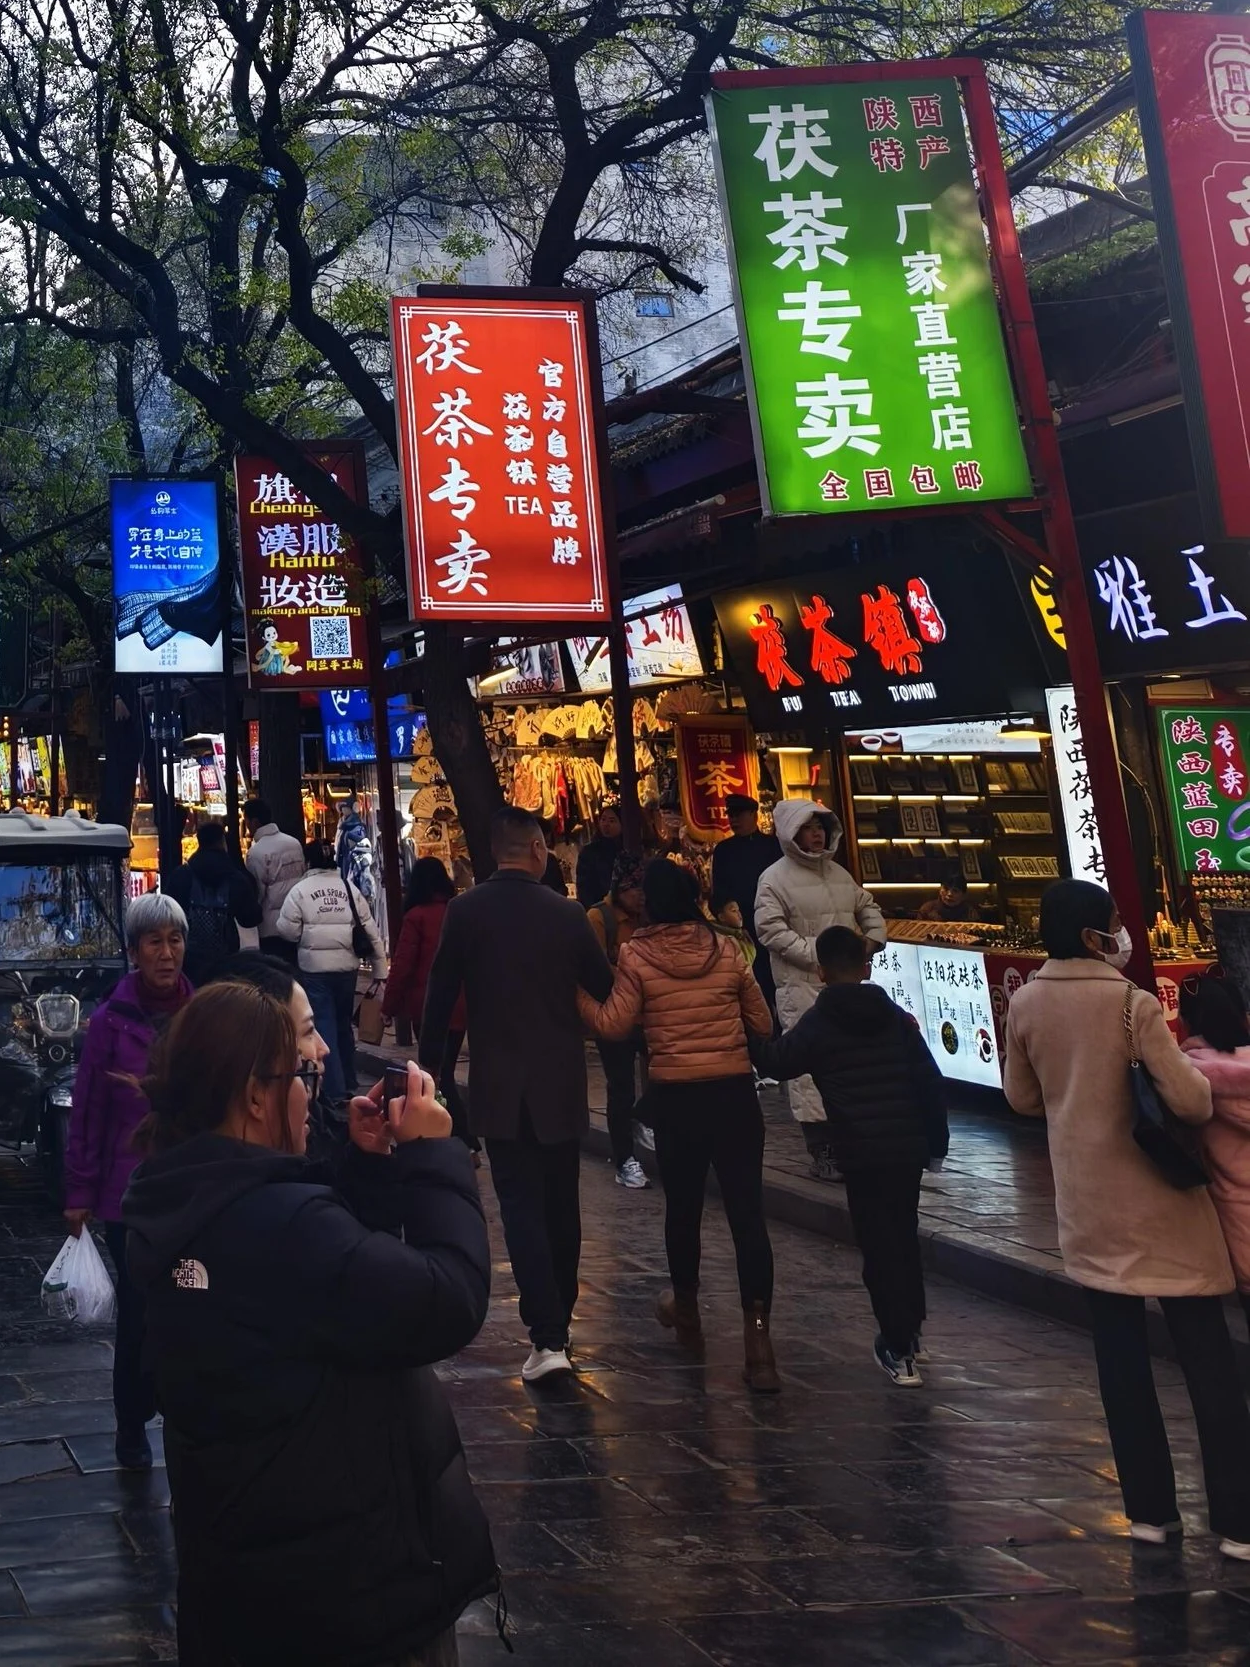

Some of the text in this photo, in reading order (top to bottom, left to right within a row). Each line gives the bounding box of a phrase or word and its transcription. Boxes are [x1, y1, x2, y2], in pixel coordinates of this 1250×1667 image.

[863, 93, 944, 132] 陕西
[869, 134, 951, 173] 特产
[748, 103, 883, 458] 茯茶专卖
[896, 202, 973, 451] 厂家直营店
[415, 320, 494, 597] 茯茶专卖
[502, 392, 544, 516] 茯茶镇 TEA
[537, 357, 583, 566] 官方自营品牌
[819, 461, 984, 501] 全国包邮
[269, 553, 336, 568] Hanfu
[251, 605, 362, 618] makeup and styling
[749, 584, 923, 692] 茯茶镇
[306, 658, 365, 672] 阿兰手工坊
[830, 689, 862, 707] TEA
[888, 681, 938, 703] TOWN
[694, 759, 744, 799] 茶
[707, 806, 729, 820] TE
[323, 897, 338, 905] CLUB
[923, 959, 984, 991] 泾阳茯砖茶
[171, 1268, 194, 1278] NORTH
[180, 1259, 194, 1268] THE
[176, 1278, 194, 1288] FACE
